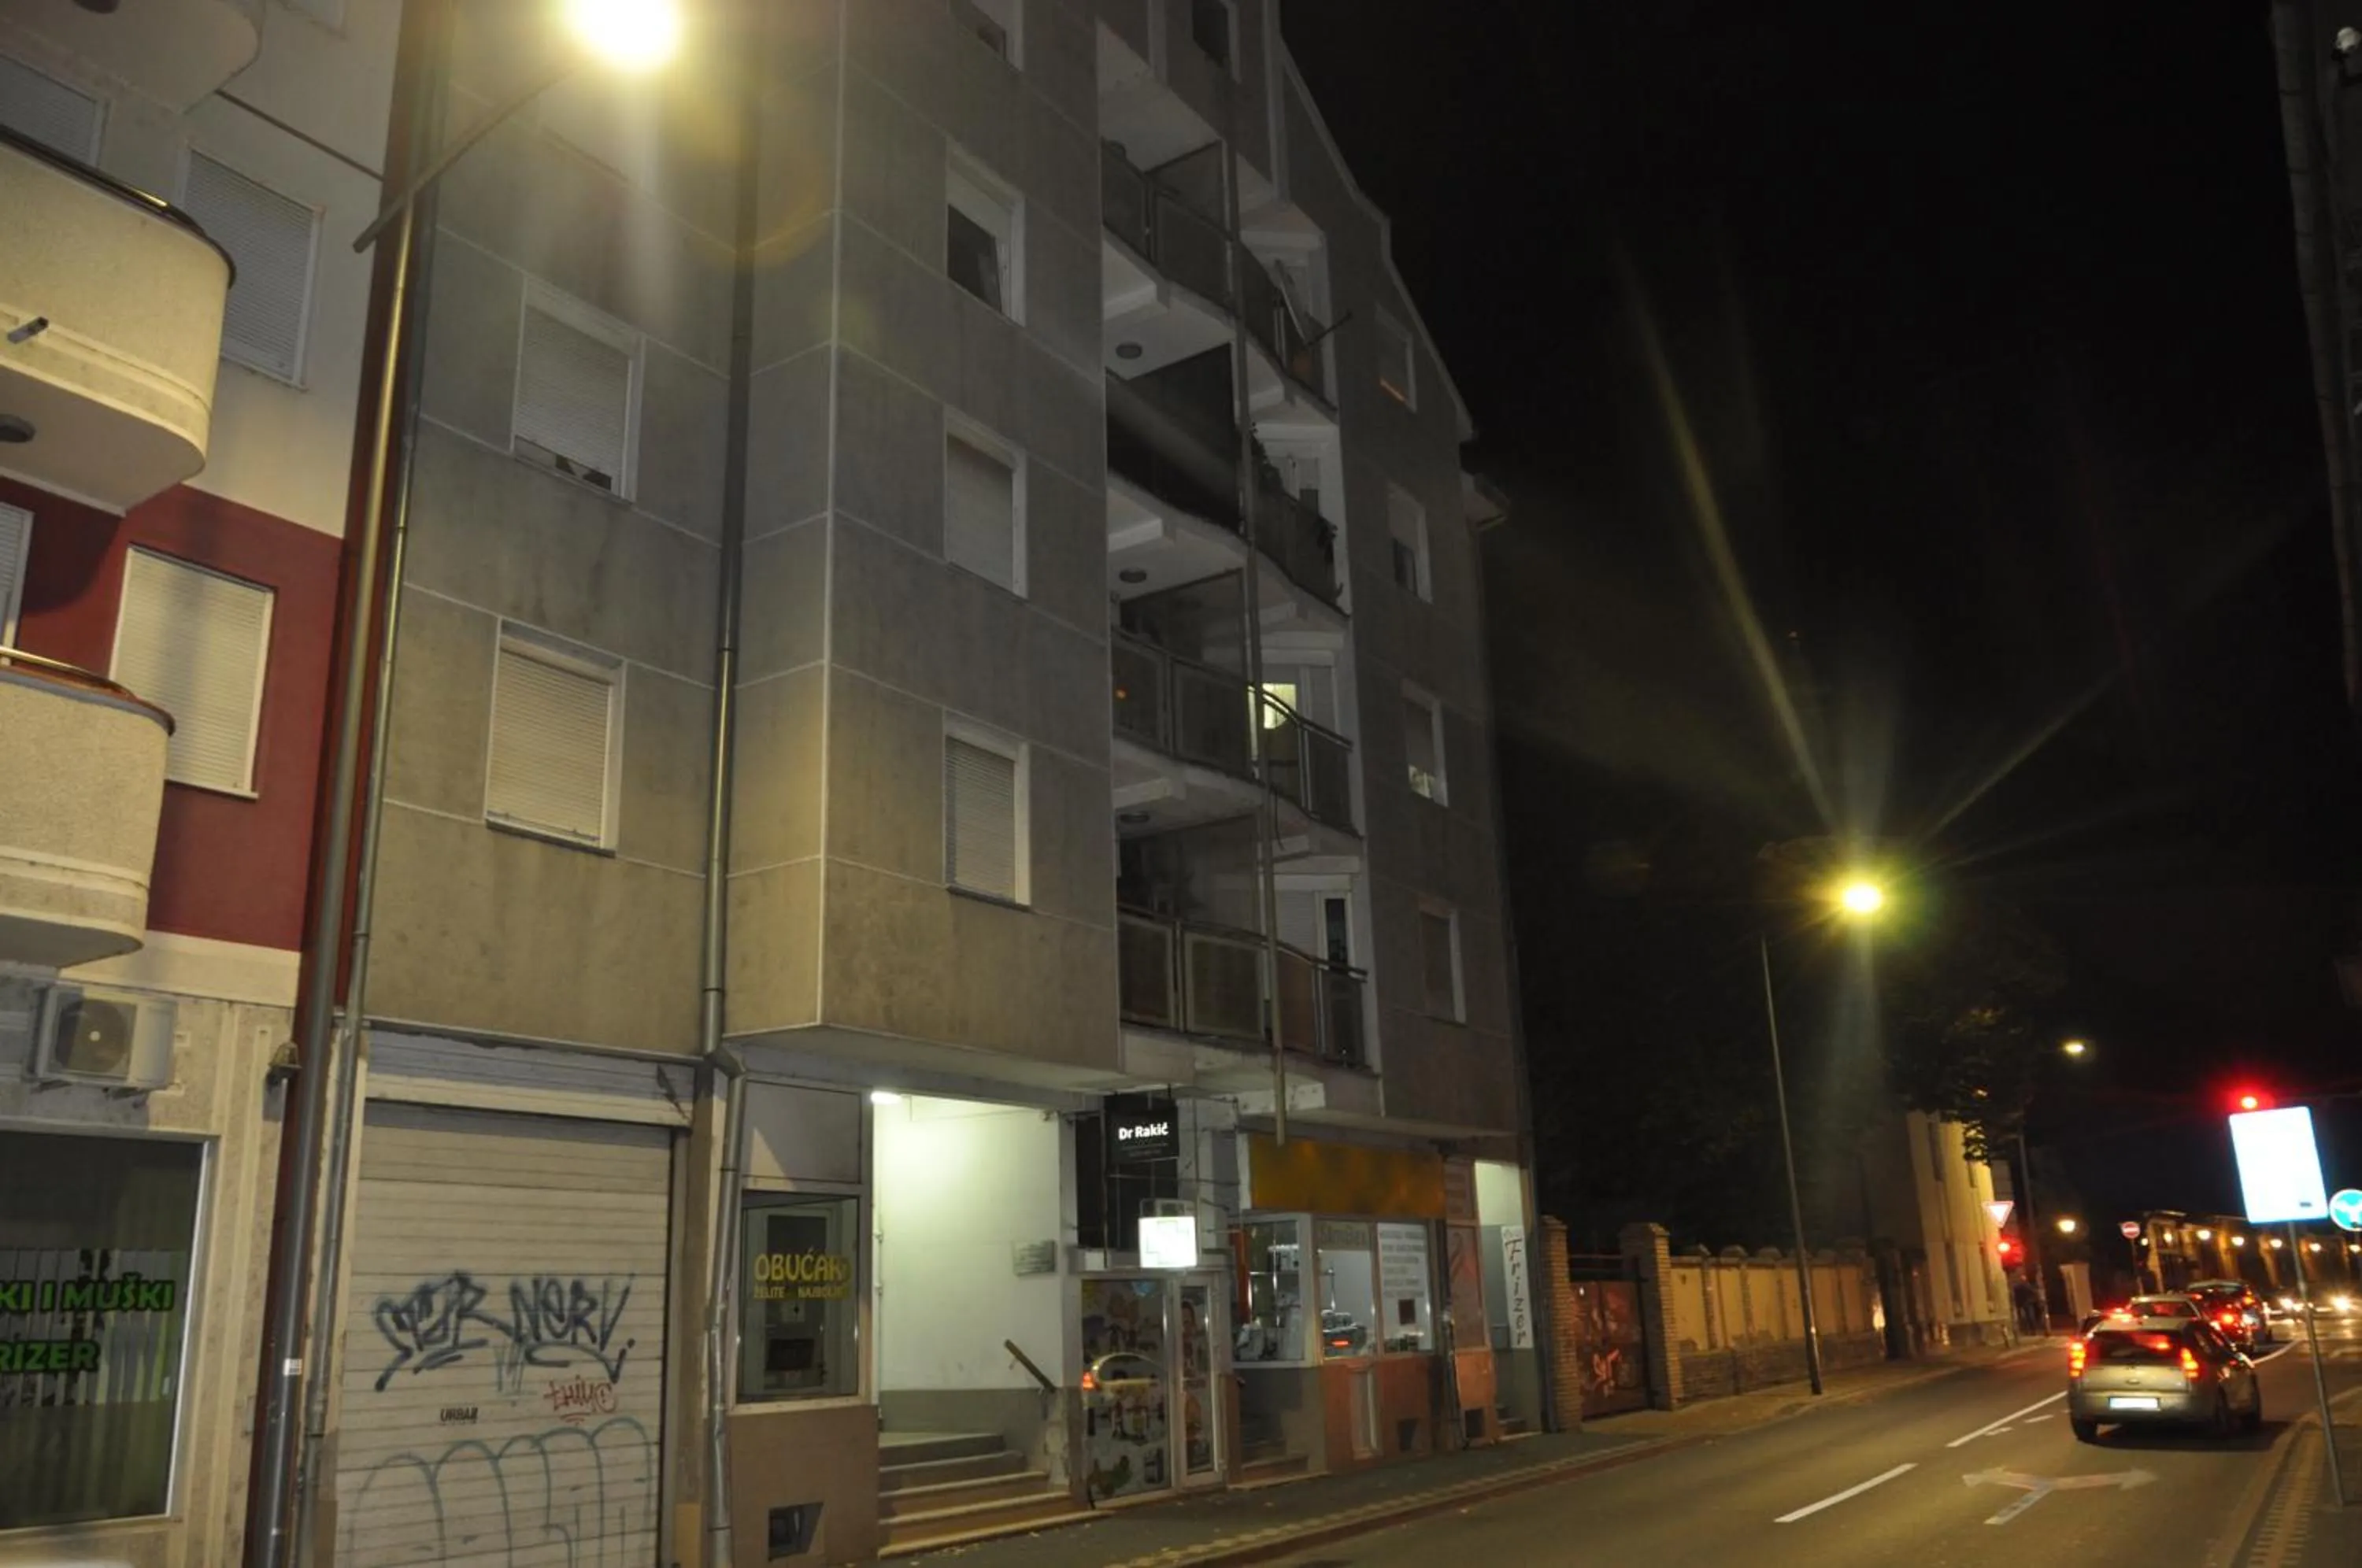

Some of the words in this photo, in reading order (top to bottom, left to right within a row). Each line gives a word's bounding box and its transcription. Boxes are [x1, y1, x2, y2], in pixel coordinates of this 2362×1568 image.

[1119, 1126, 1133, 1140] Dr
[1135, 1122, 1168, 1137] Rakić
[62, 1273, 173, 1311] MUŠKI
